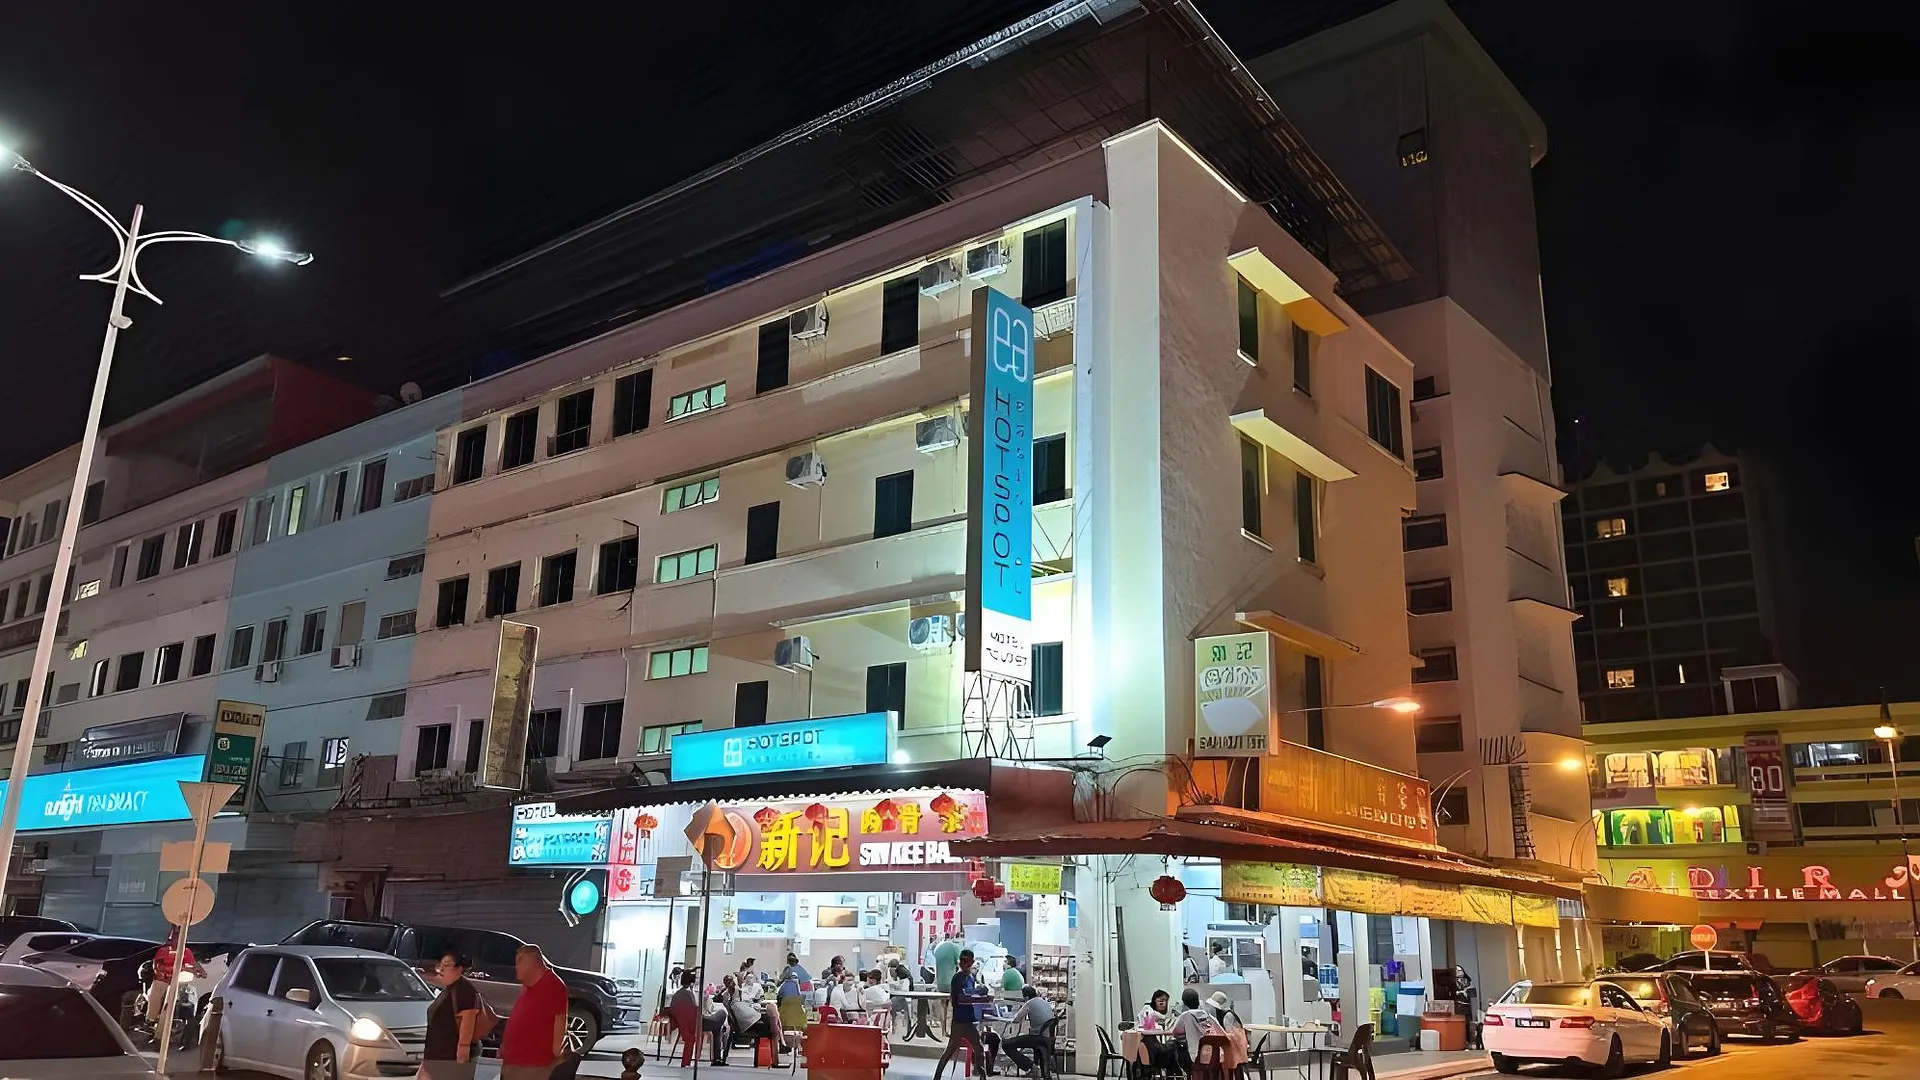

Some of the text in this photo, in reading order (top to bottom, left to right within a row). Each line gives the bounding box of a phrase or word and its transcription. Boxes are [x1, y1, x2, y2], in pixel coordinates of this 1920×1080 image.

[994, 387, 1012, 588] HOTSPOT
[891, 841, 924, 864] KEE
[926, 840, 964, 864] BA
[1820, 887, 1906, 900] MALL
